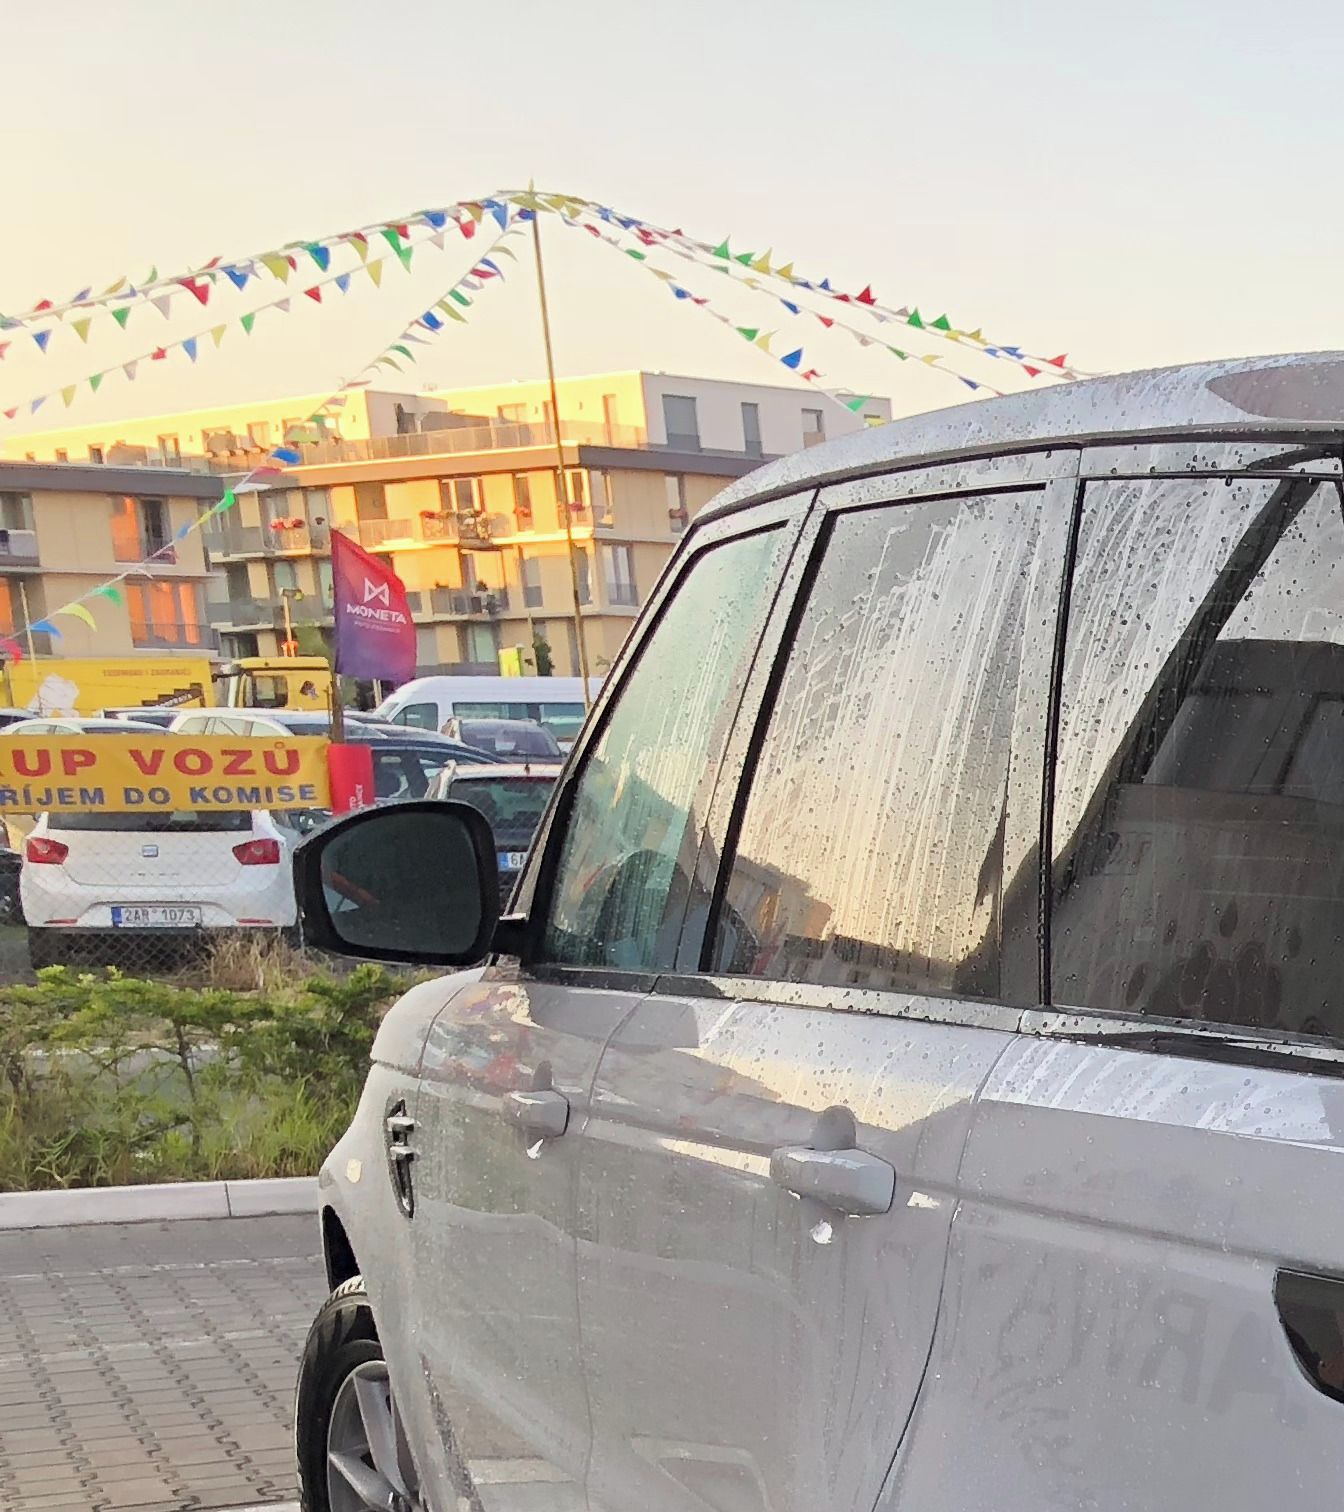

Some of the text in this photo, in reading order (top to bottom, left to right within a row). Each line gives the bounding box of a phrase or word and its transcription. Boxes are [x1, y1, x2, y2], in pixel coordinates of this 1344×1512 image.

[346, 603, 407, 625] MONETA
[0, 741, 302, 777] UP VOZŮ
[123, 786, 172, 805] DO
[189, 784, 318, 804] KOMISE
[161, 908, 196, 921] 1073
